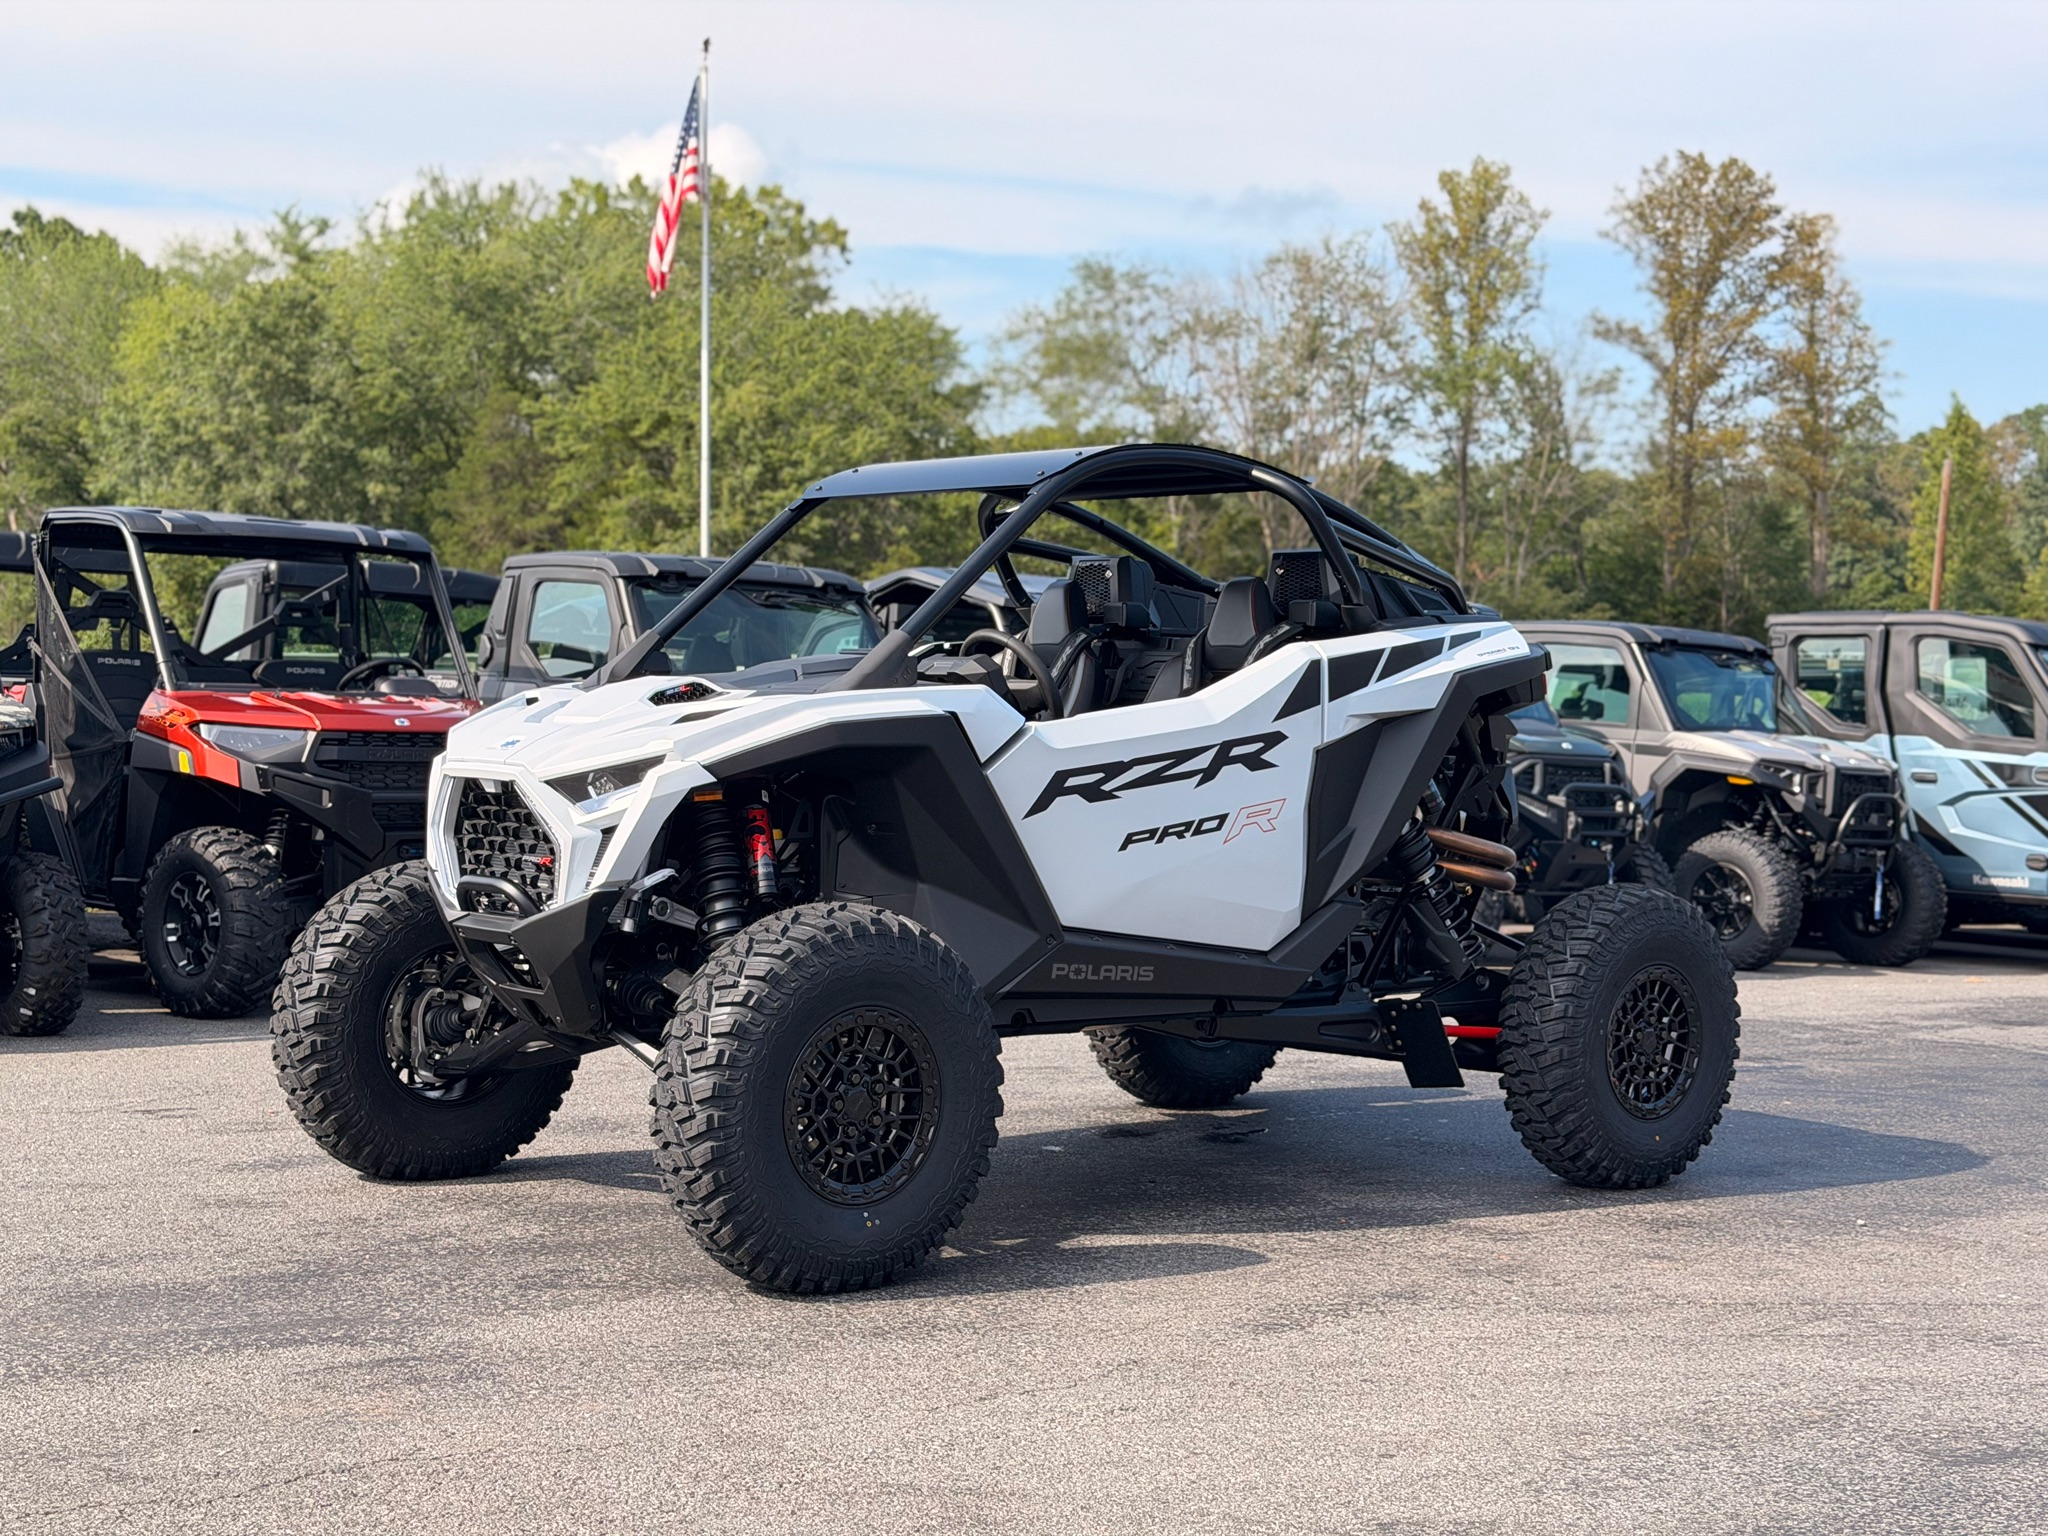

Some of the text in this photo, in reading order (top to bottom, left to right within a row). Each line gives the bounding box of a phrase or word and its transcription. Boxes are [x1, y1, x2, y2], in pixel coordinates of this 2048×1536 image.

[98, 657, 141, 666] POLARIS
[1021, 730, 1289, 820] RZR
[747, 809, 776, 862] FOX
[1117, 798, 1286, 852] PRO R
[1972, 874, 2029, 888] Kawasaki
[1051, 963, 1154, 981] POLARIS
